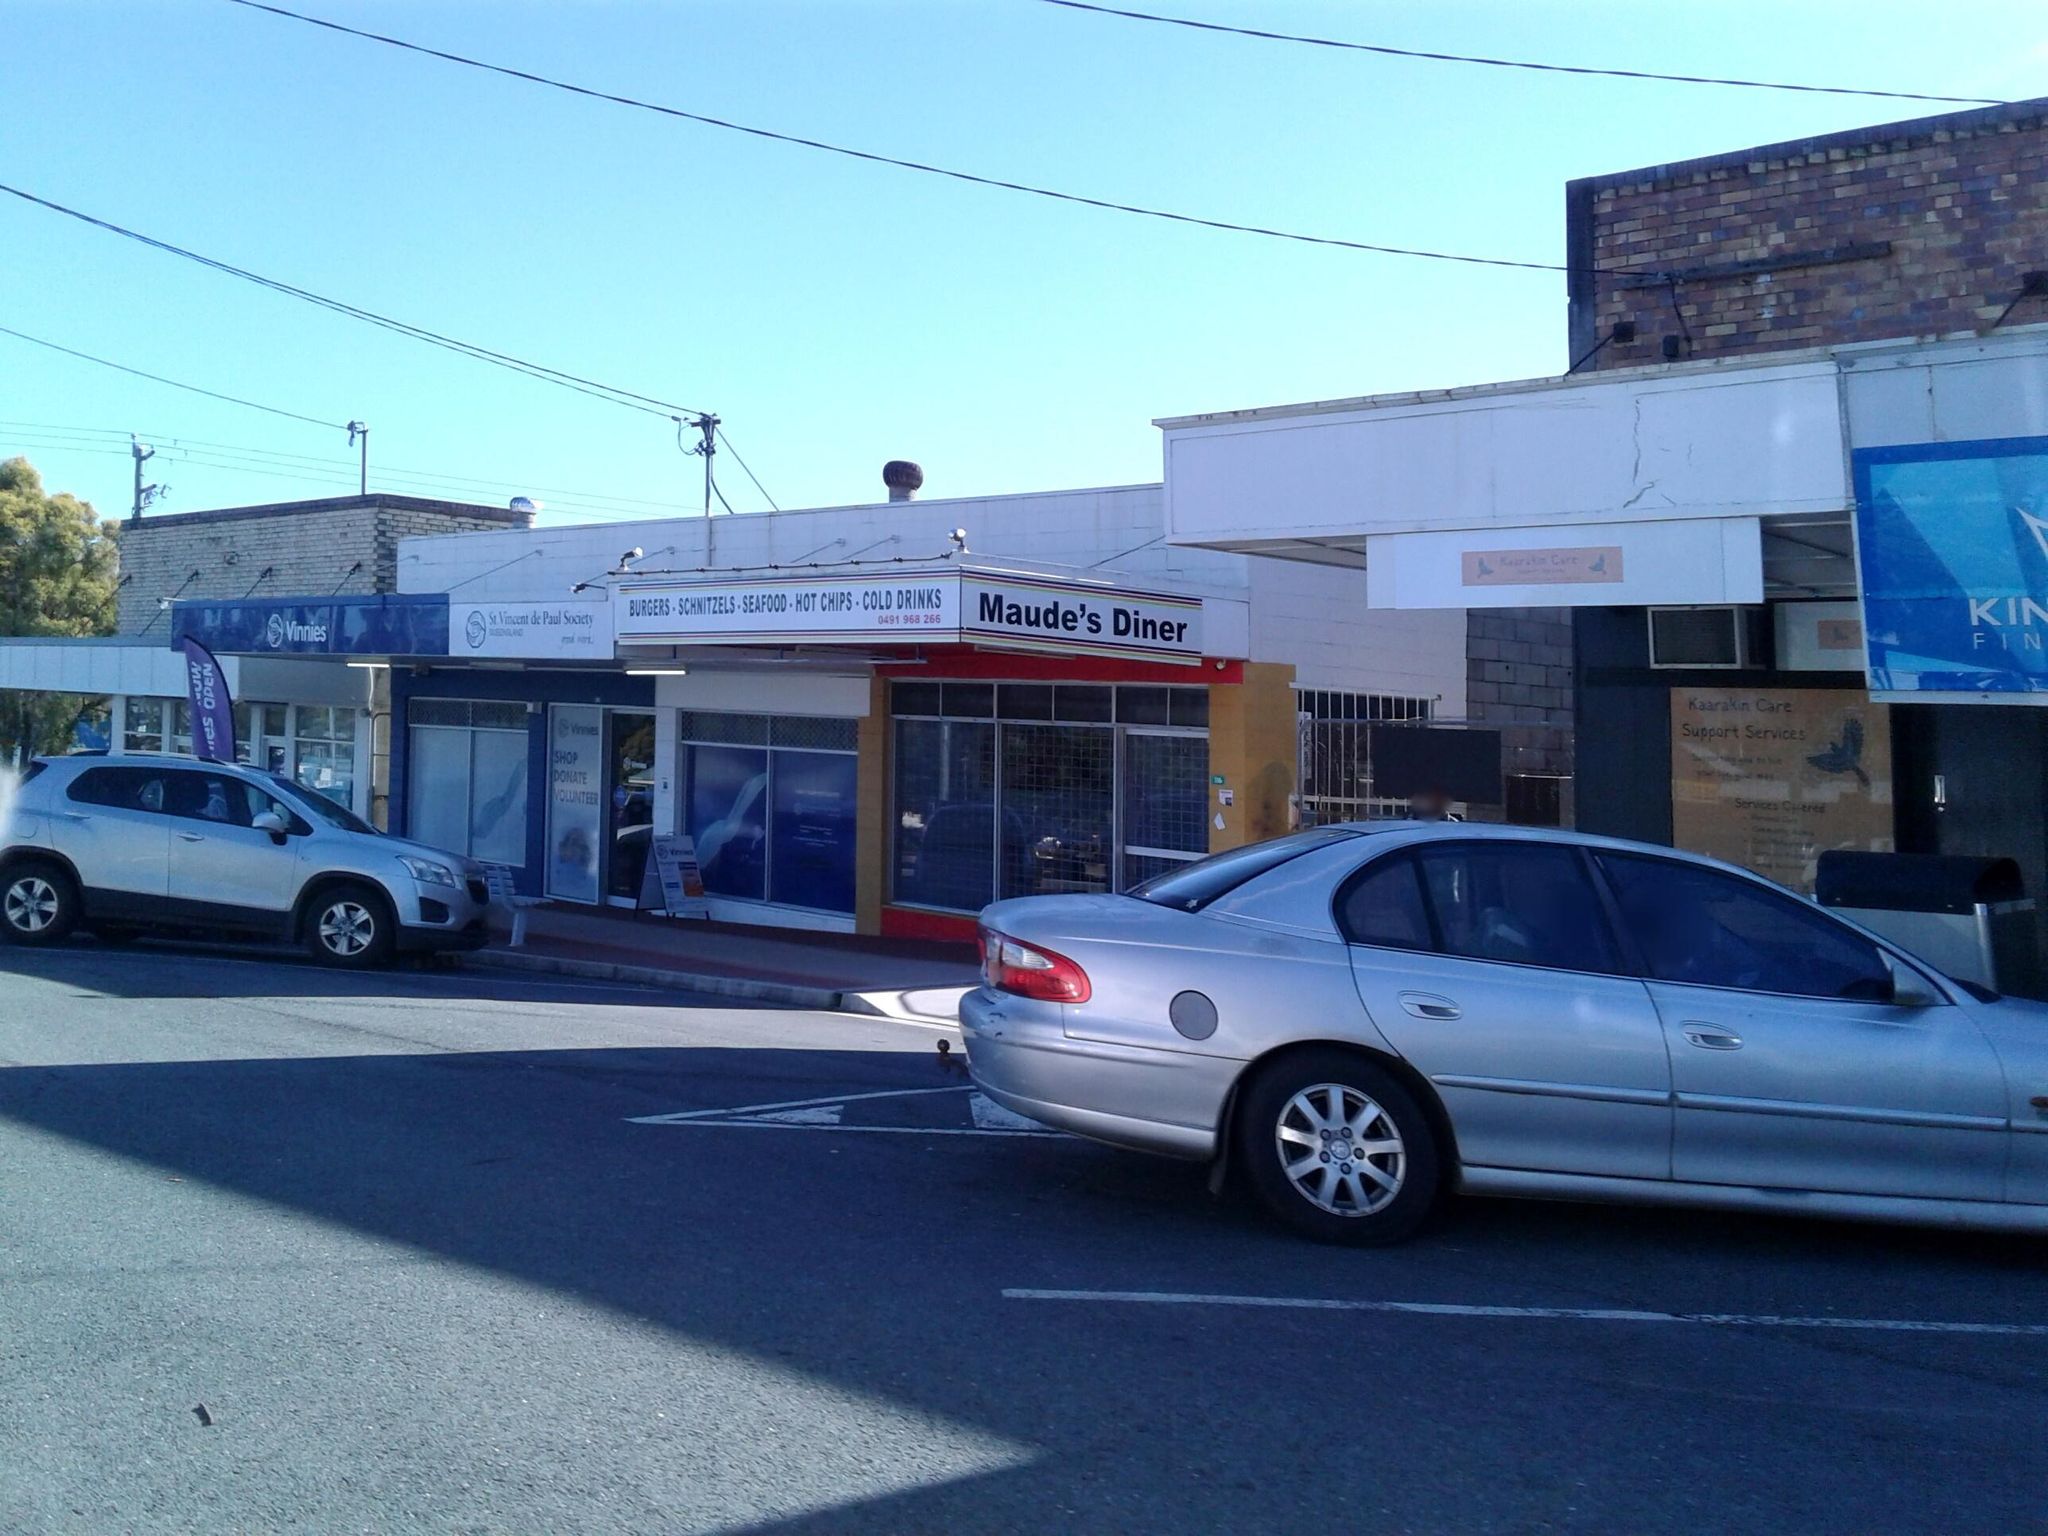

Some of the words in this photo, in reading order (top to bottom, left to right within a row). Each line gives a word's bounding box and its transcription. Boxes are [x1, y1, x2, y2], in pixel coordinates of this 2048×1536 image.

[629, 598, 670, 617] BURGERS
[678, 595, 736, 615] SCHNITZELS
[742, 593, 787, 614] SEAFOOD
[795, 592, 817, 612] HOT
[820, 591, 853, 612] CHIPS
[862, 590, 893, 611] COLD
[896, 588, 942, 610] DRINKS
[488, 611, 497, 626] St
[499, 611, 529, 626] Vincent
[530, 610, 542, 625] de
[542, 610, 562, 625] Paul
[563, 609, 595, 629] Society
[877, 614, 900, 625] 0491
[902, 614, 921, 624] 968
[923, 613, 942, 624] 266
[979, 592, 1101, 634] Maude's
[1112, 607, 1188, 643] Diner
[285, 620, 327, 642] Vinnies
[190, 661, 204, 706] OW
[202, 663, 216, 710] OPEN
[1688, 696, 1750, 711] Kaarakin
[1756, 698, 1793, 713] Care
[1682, 723, 1740, 742] Support
[1745, 725, 1807, 741] Services
[554, 751, 578, 765] SHOP
[553, 770, 588, 785] DONATE
[1734, 797, 1778, 811] Services
